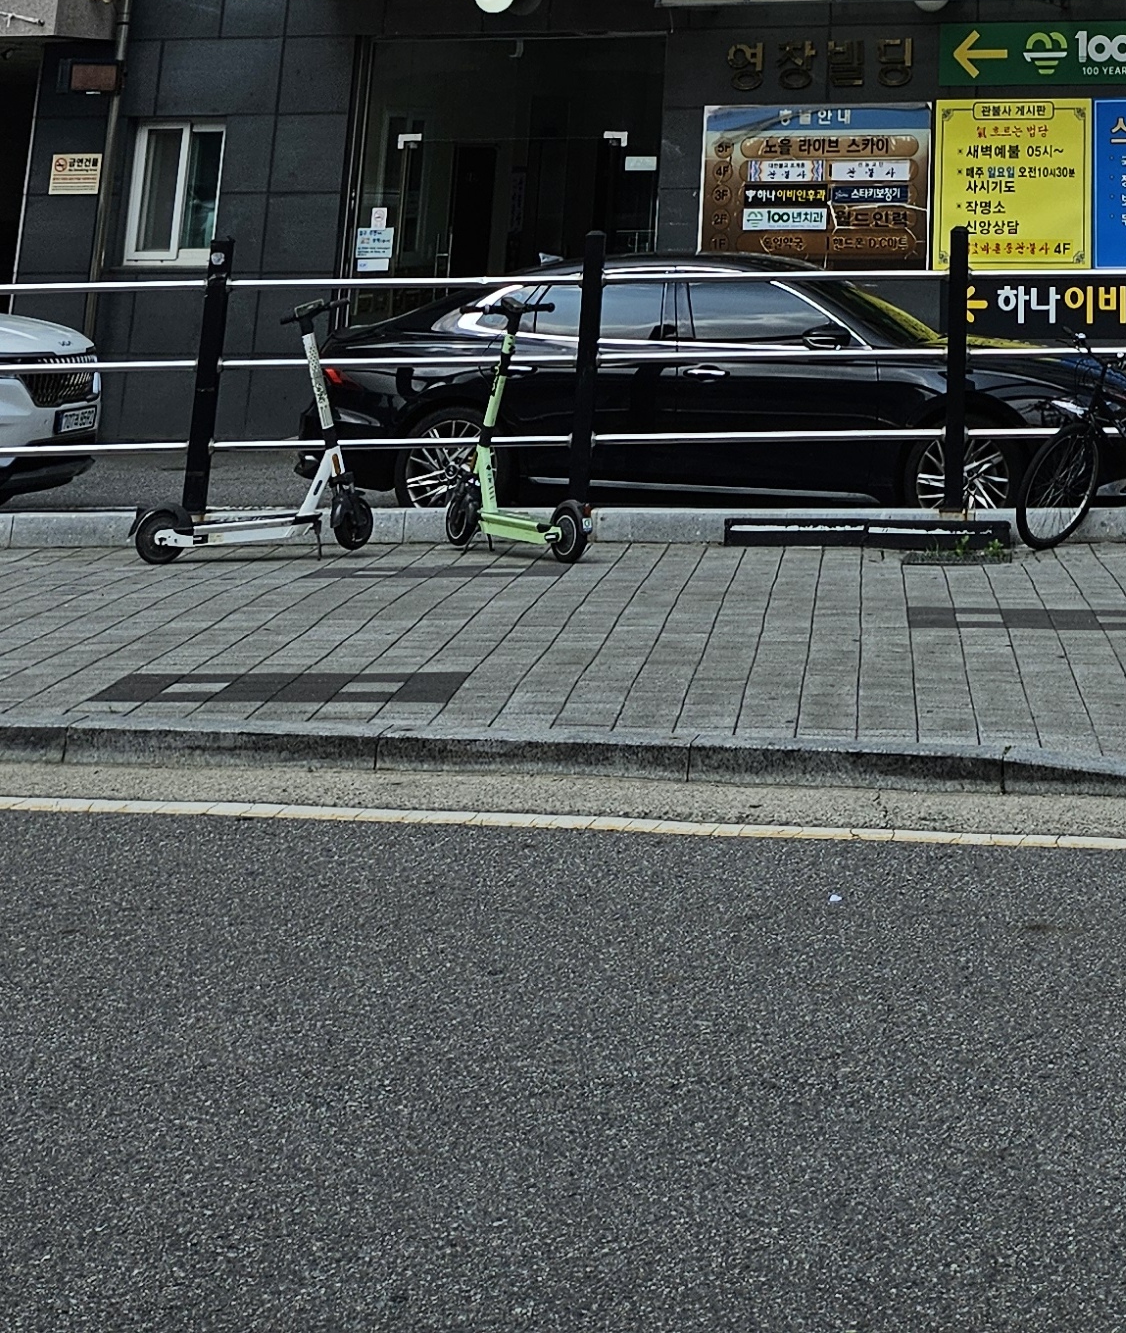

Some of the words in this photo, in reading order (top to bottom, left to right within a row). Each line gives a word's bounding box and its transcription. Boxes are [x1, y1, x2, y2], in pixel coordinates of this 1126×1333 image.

[1082, 66, 1099, 76] 100
[981, 105, 1012, 117] 관불사
[1015, 105, 1046, 117] 게시판
[1026, 124, 1049, 138] 법당
[763, 138, 793, 155] 노을
[798, 138, 841, 155] 라이브
[846, 137, 889, 155] 스카이
[966, 144, 1020, 159] 새벽예불
[715, 165, 730, 176] 4F
[966, 166, 985, 179] 매주
[987, 166, 1016, 179] 일요일
[966, 179, 1016, 194] 사시기도
[714, 189, 729, 201] 3F
[757, 189, 827, 202] 하나이비인후과
[850, 187, 901, 202] 스타키보청기
[965, 200, 1006, 215] 작명소
[713, 212, 728, 224] 2F
[766, 209, 824, 223] 100년치과
[966, 219, 1020, 235] 신앙상담
[710, 238, 726, 249] 1F
[1053, 242, 1071, 255] 4F
